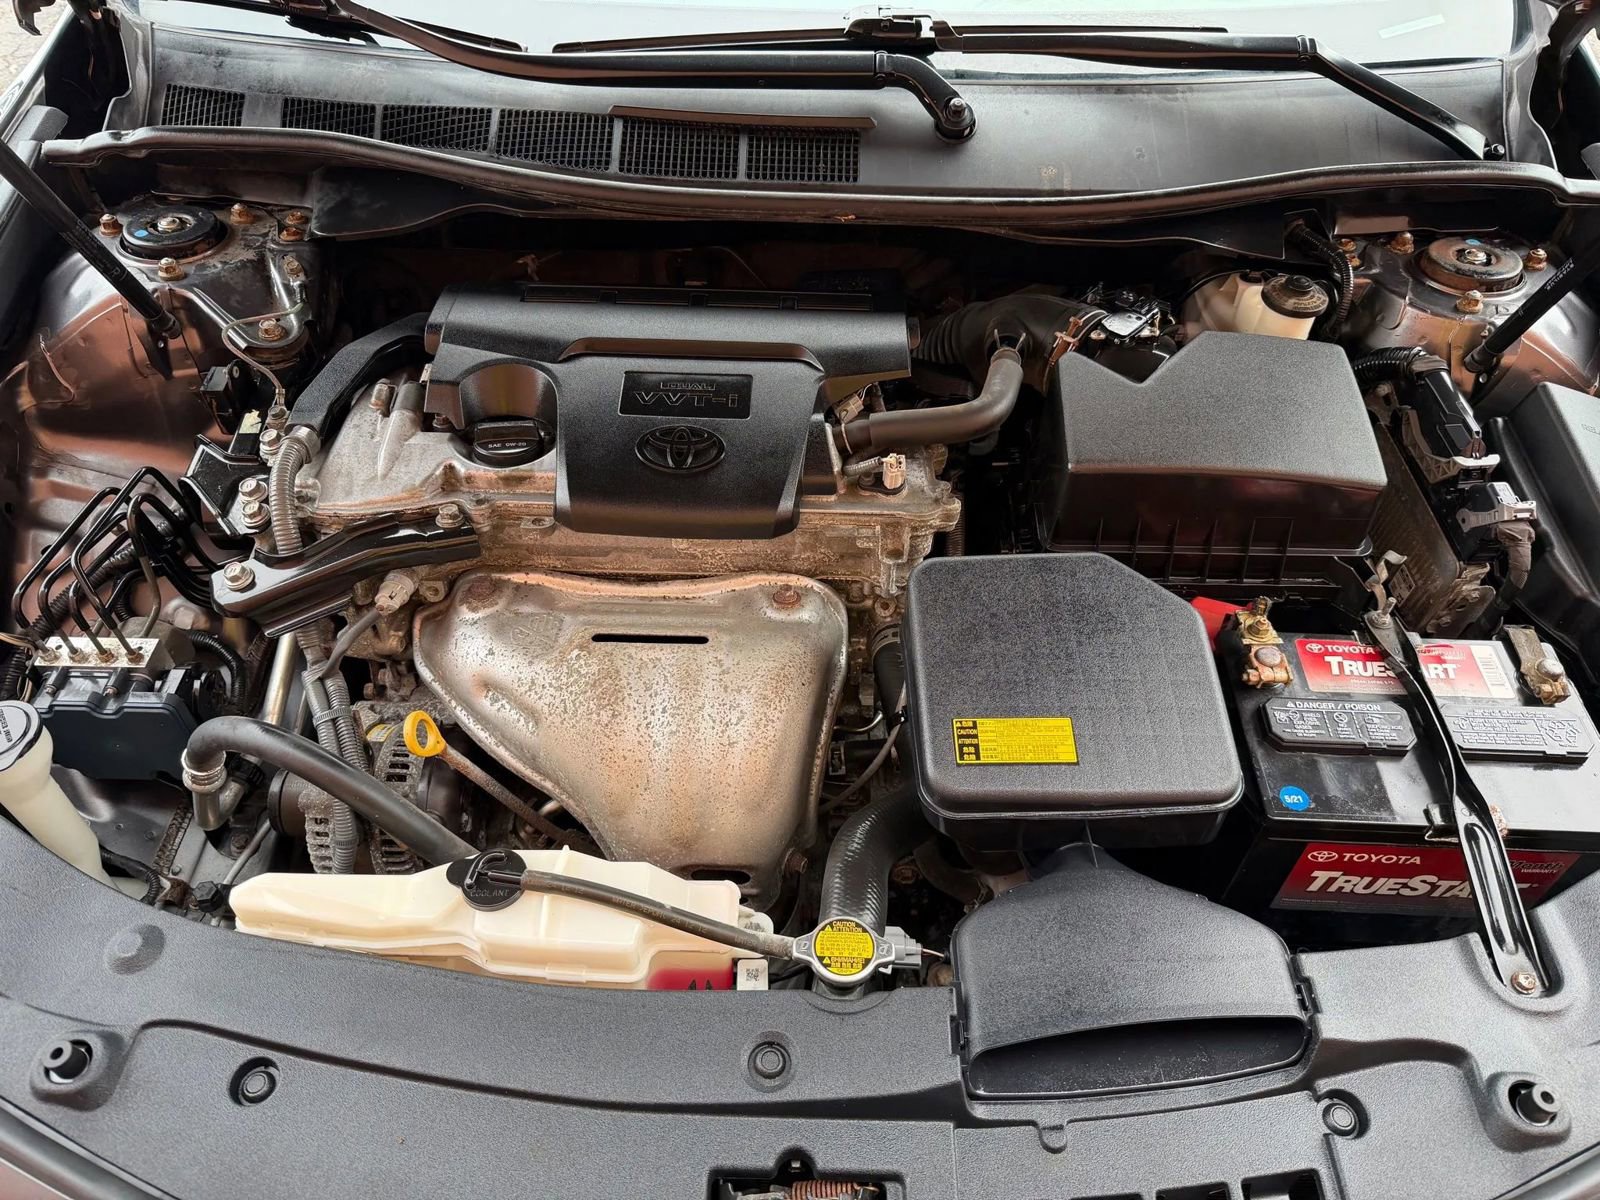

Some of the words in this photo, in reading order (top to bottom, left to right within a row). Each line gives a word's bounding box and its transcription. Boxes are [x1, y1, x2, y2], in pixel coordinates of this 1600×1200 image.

[633, 391, 739, 408] VVT-i
[1325, 645, 1375, 655] TOYOTA
[1296, 701, 1335, 710] DANGER
[1344, 703, 1381, 711] POISON
[1283, 794, 1304, 804] 5/21
[1342, 853, 1421, 865] TOYOTA
[470, 888, 510, 898] COOLANT
[832, 920, 856, 928] CAUTION
